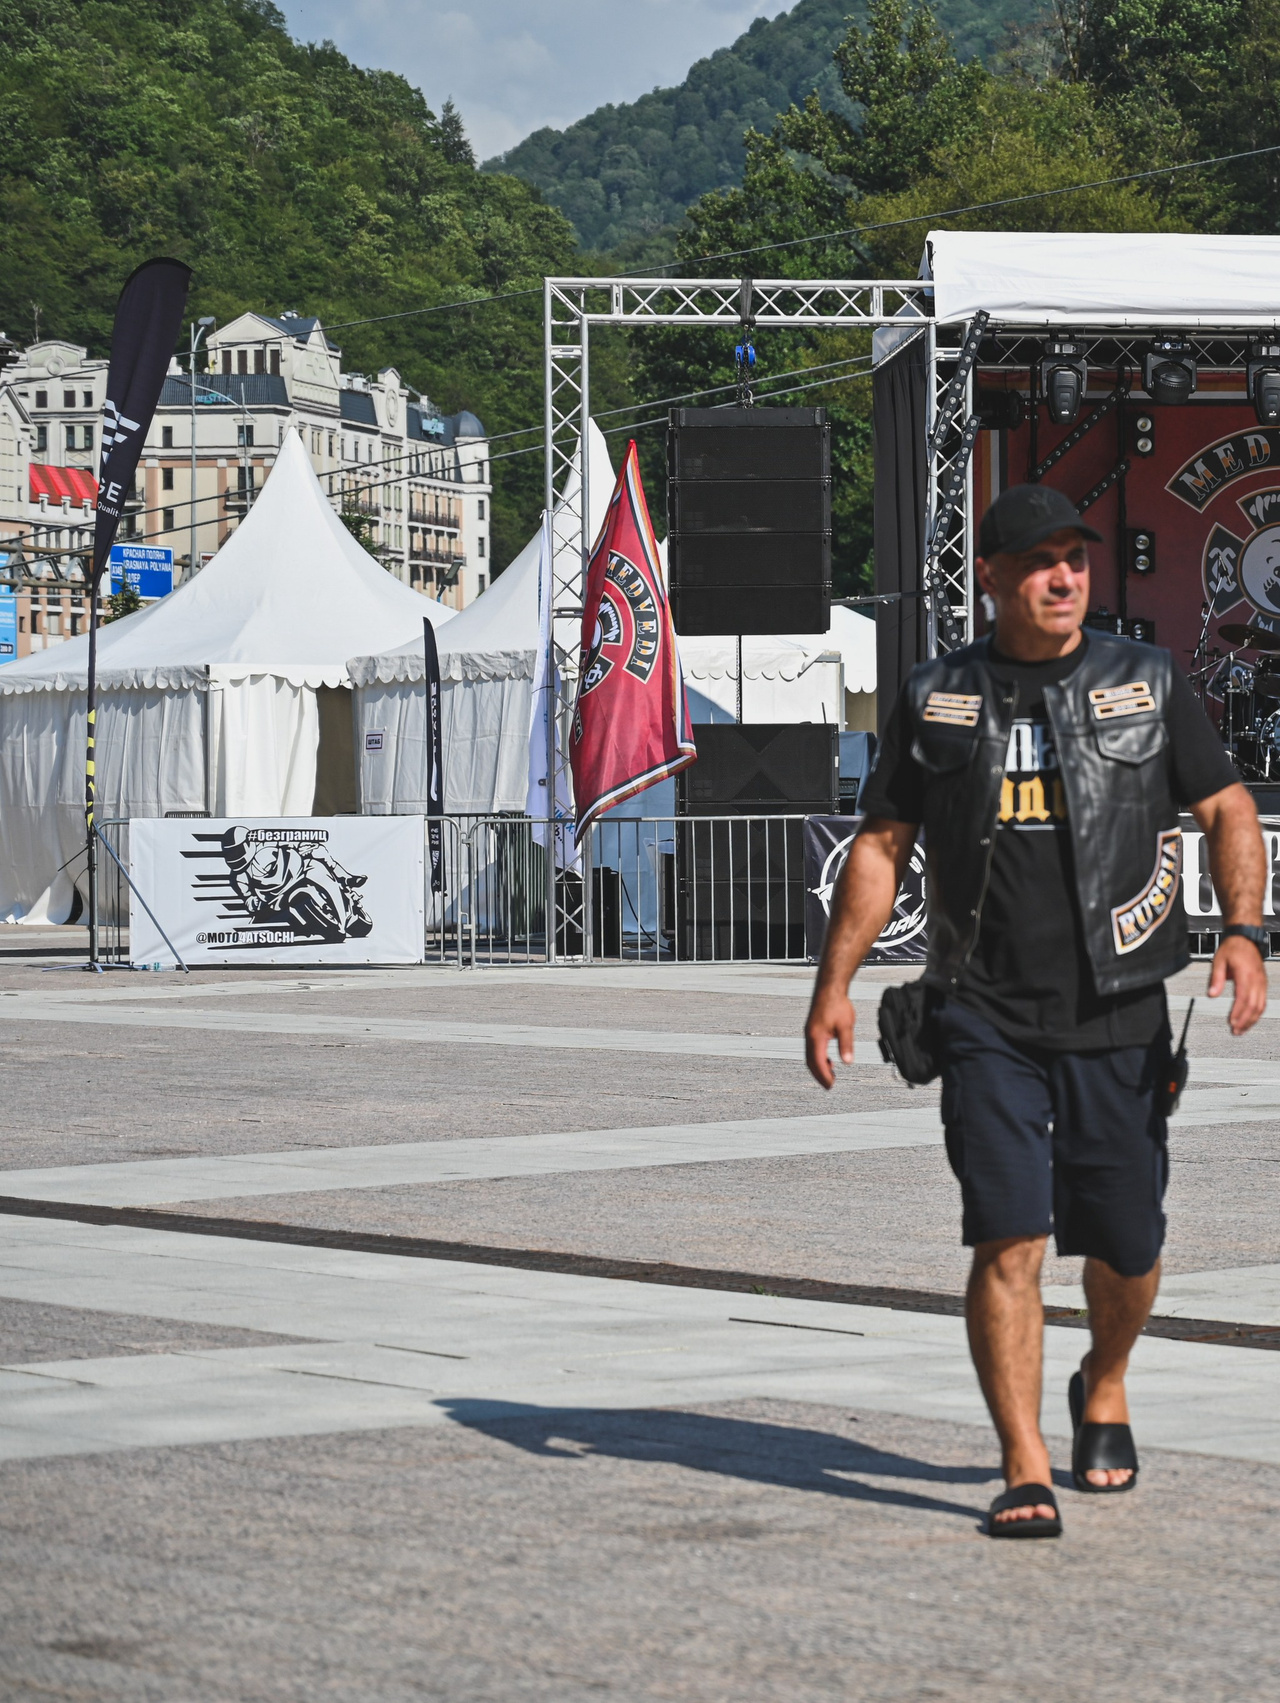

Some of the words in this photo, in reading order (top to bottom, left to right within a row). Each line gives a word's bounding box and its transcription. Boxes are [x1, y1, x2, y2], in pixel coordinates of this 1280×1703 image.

[97, 501, 121, 519] Qualit
[150, 562, 172, 572] POLYANA
[124, 573, 141, 583] ДЛЕР
[606, 552, 656, 673] MEDVEDI
[247, 829, 327, 842] #безграниц
[1117, 841, 1178, 944] RUSSIA
